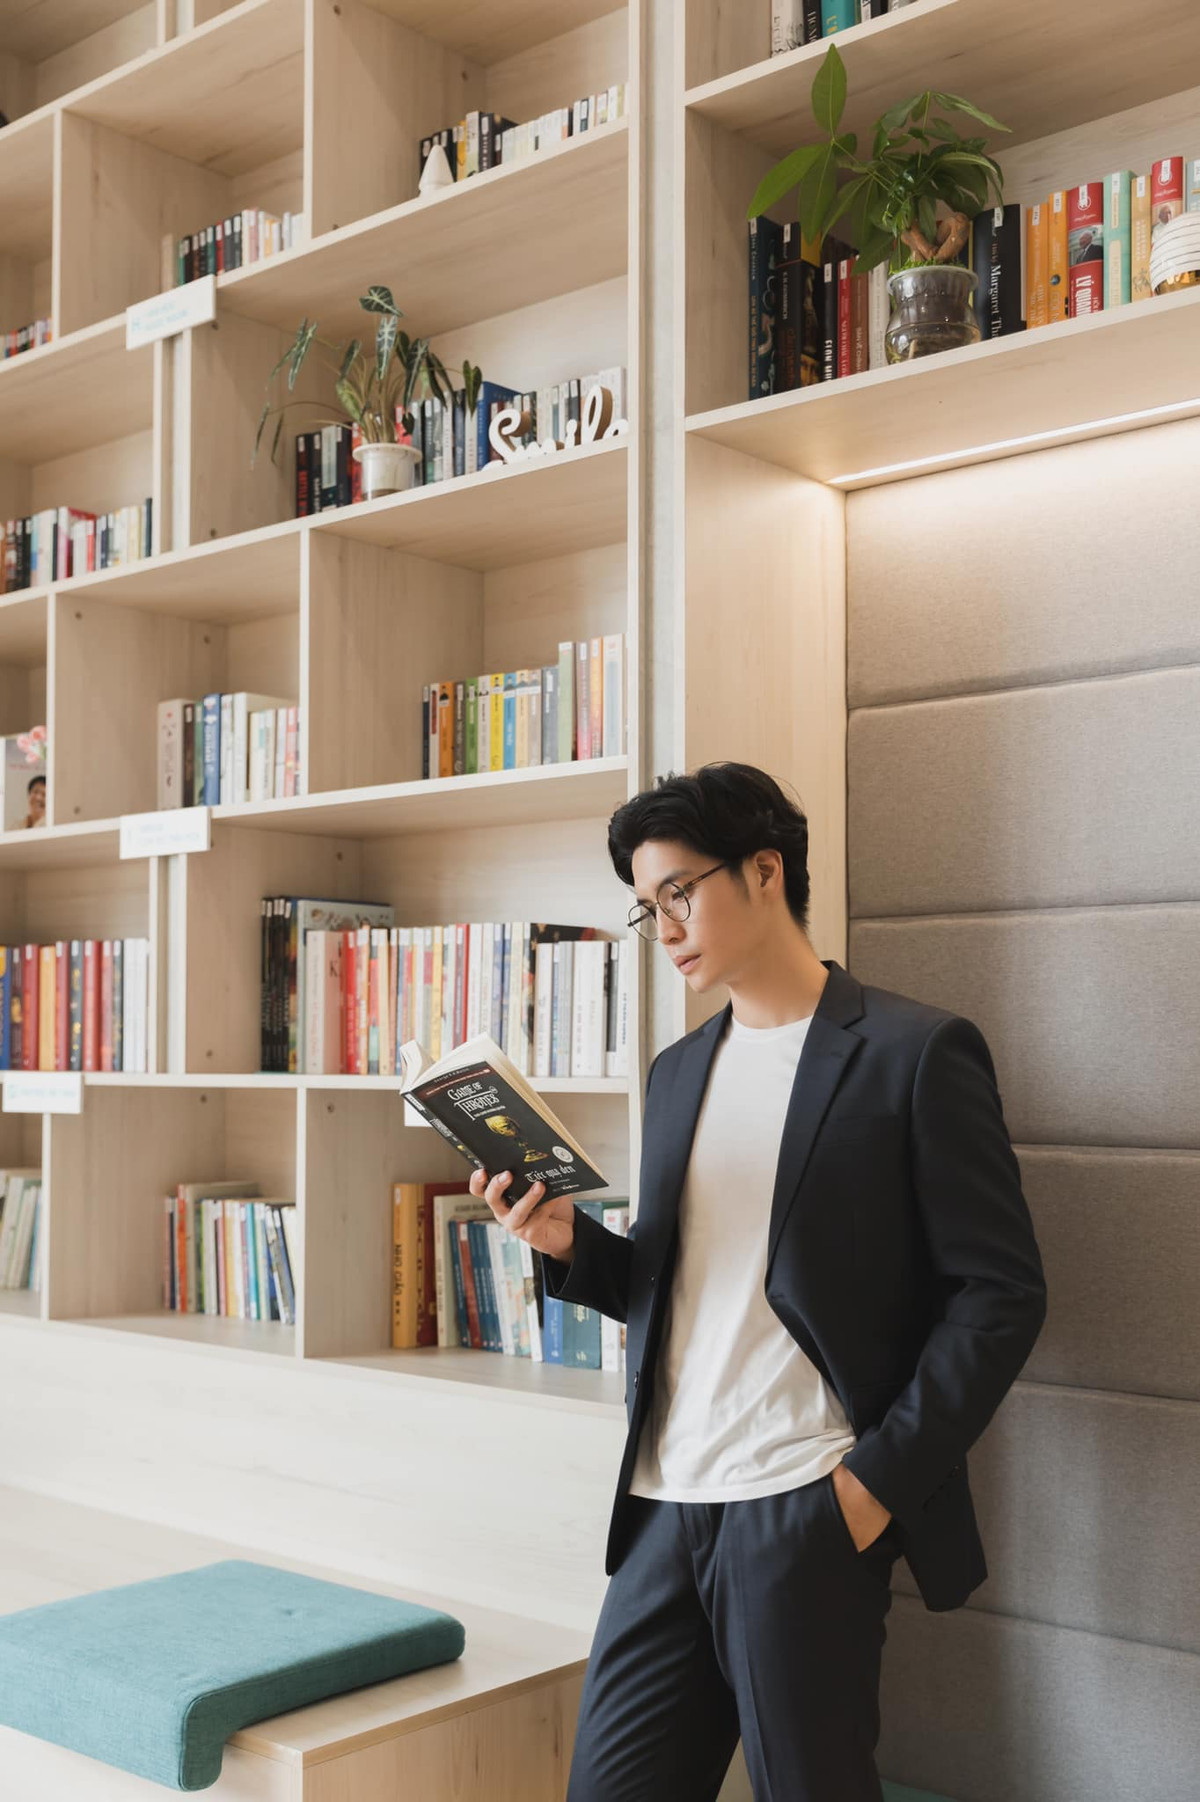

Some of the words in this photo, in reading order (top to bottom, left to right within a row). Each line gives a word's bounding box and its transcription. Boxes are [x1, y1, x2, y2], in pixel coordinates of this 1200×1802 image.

[988, 264, 1001, 315] Margaret
[447, 1085, 476, 1100] GAME
[472, 1082, 482, 1091] OF
[454, 1091, 500, 1121] THRONES
